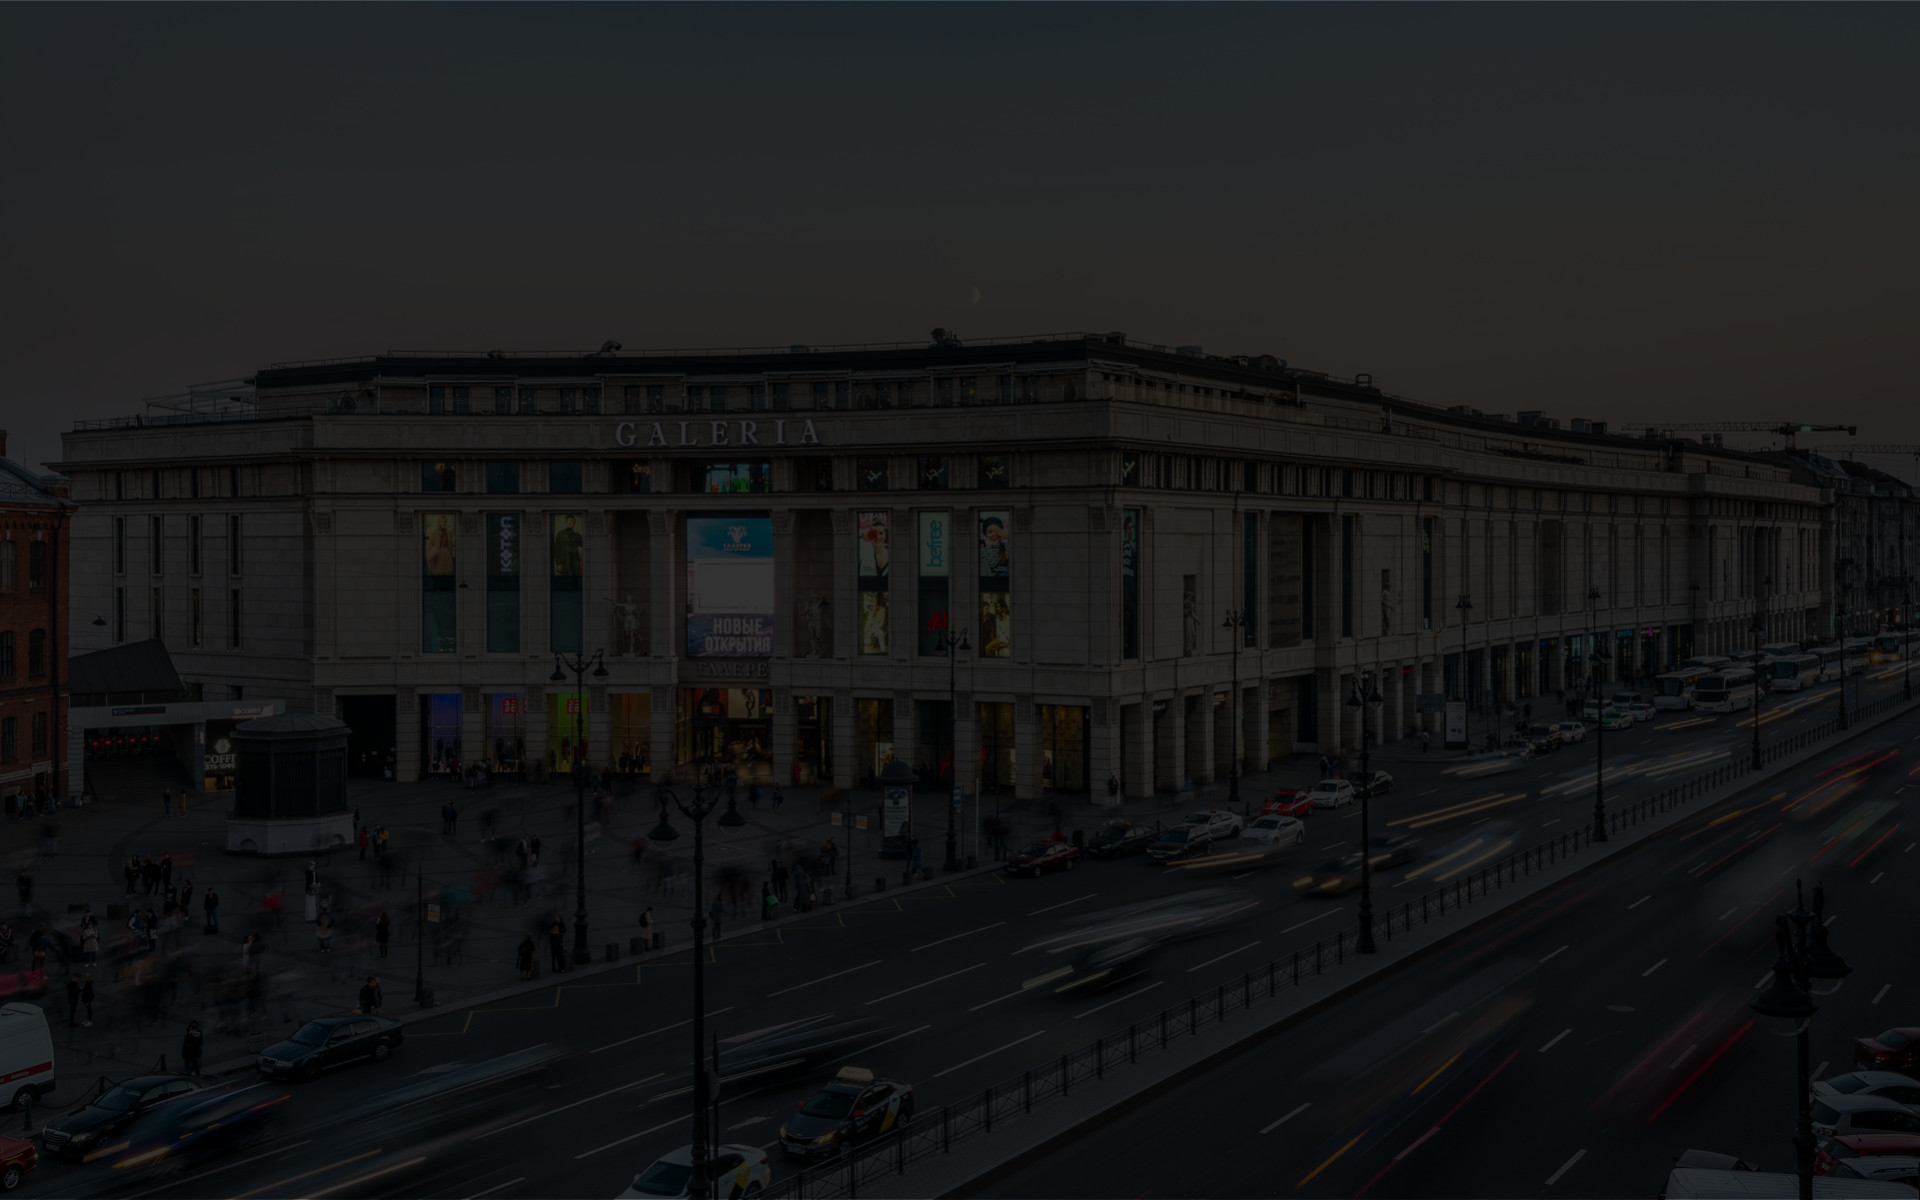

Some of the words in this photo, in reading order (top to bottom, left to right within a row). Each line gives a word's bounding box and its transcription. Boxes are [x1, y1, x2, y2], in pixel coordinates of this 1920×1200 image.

[615, 419, 820, 446] GALERIA
[926, 520, 943, 567] befree
[713, 618, 763, 634] НОВЫЕ
[705, 636, 771, 652] ОТКРЫТИЯ
[697, 662, 769, 678] ГАЛЕРЕ
